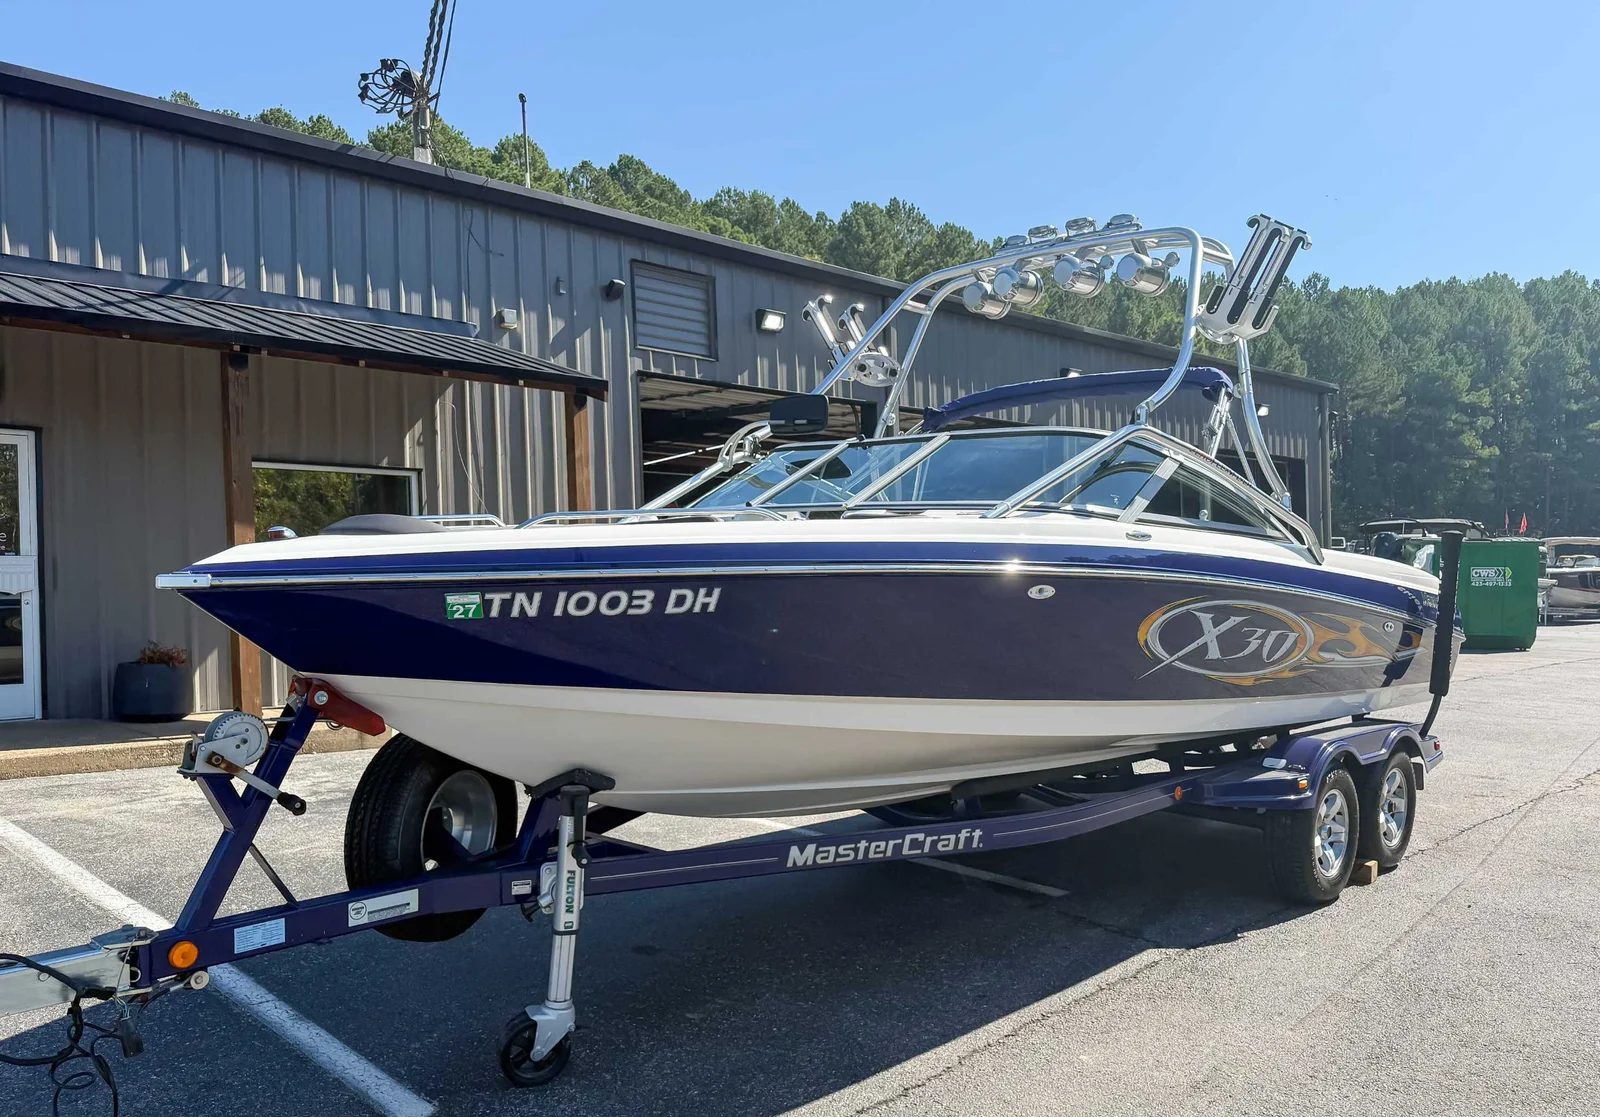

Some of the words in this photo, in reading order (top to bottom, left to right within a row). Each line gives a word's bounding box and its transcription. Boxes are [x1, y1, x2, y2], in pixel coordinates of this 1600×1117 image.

[1472, 569, 1496, 578] CWS
[453, 604, 477, 618] 27
[484, 592, 543, 618] TN
[553, 590, 656, 617] 1003
[664, 587, 722, 615] DH
[1138, 609, 1300, 680] X30
[786, 828, 983, 868] MasterCraft
[565, 870, 576, 914] FULTON
